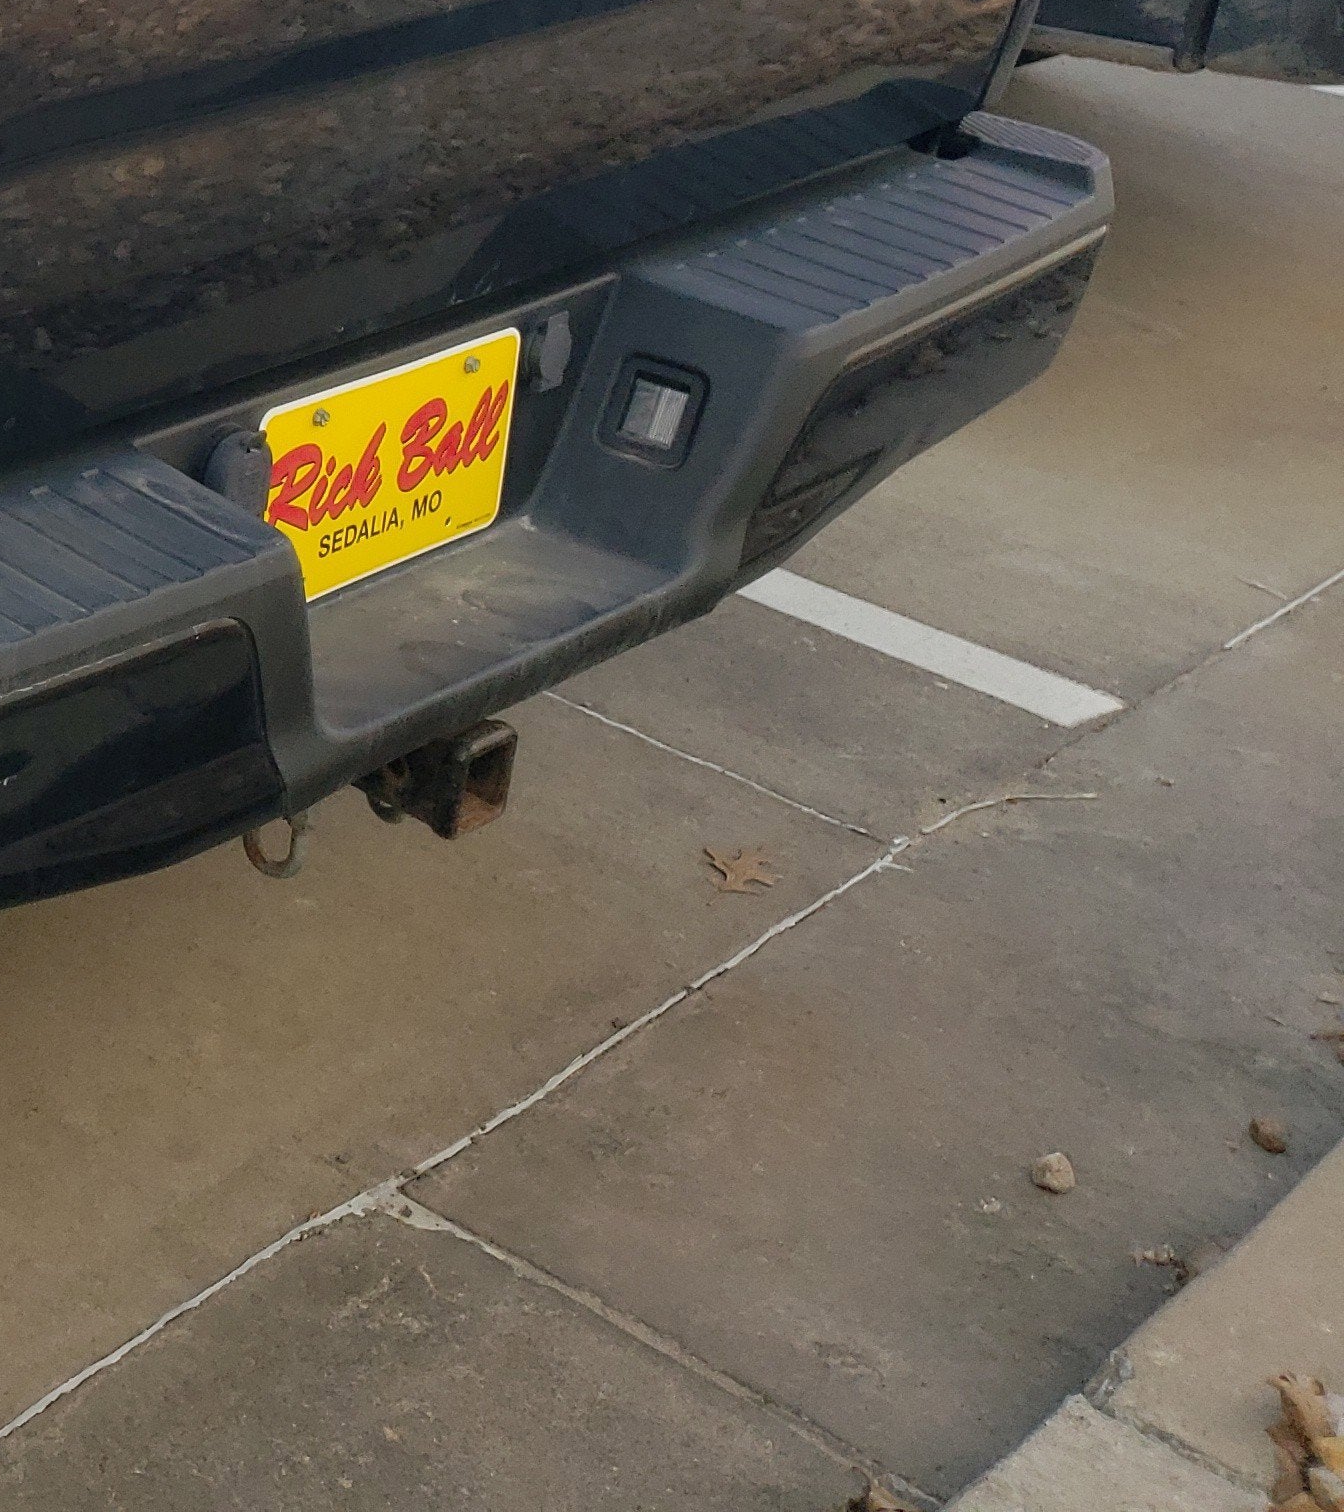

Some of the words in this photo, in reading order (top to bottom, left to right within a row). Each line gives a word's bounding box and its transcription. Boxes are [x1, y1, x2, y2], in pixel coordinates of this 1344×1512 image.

[268, 422, 388, 532] Rick
[397, 380, 510, 493] Ball
[318, 507, 406, 560] SEDALIA,
[411, 490, 444, 521] MO
